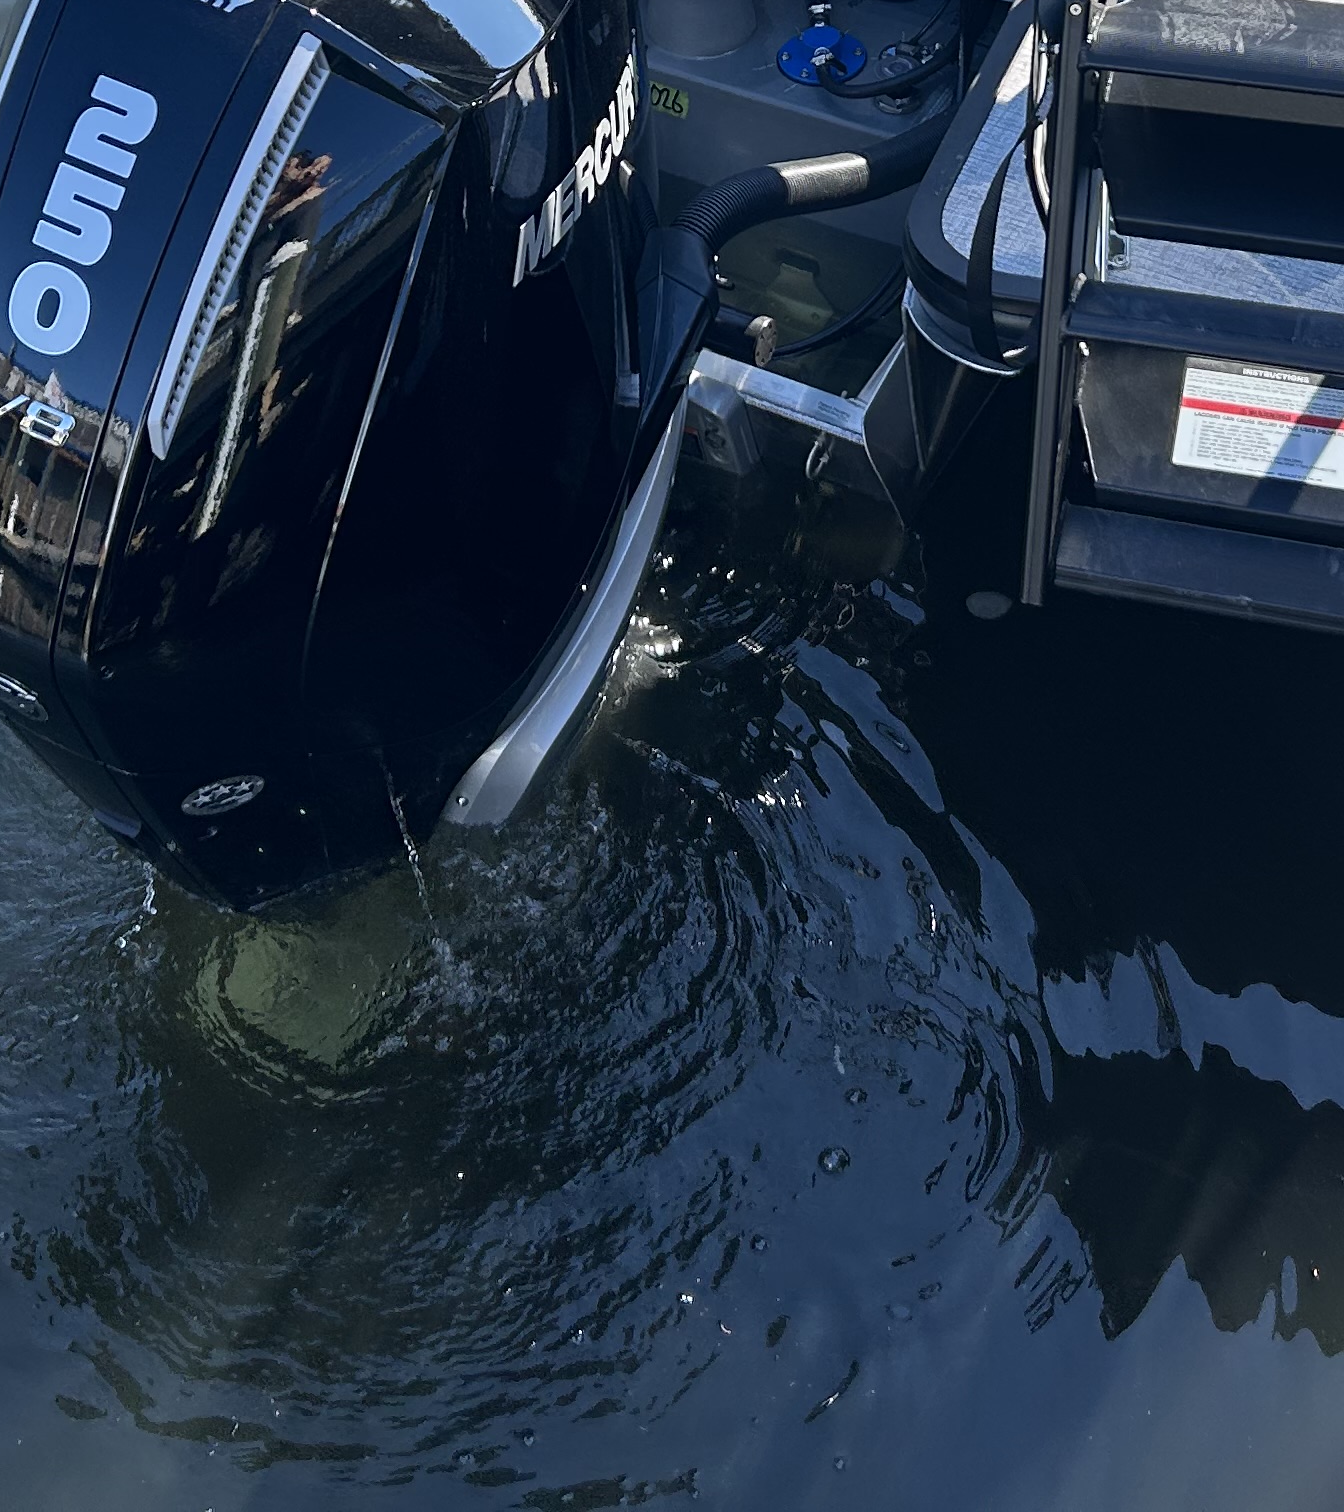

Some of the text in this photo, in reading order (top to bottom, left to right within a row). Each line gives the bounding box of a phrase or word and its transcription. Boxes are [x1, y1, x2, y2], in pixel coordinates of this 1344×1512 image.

[8, 74, 158, 356] 250
[513, 53, 637, 288] MERCUR
[1242, 367, 1310, 384] INSTRUCTIONS
